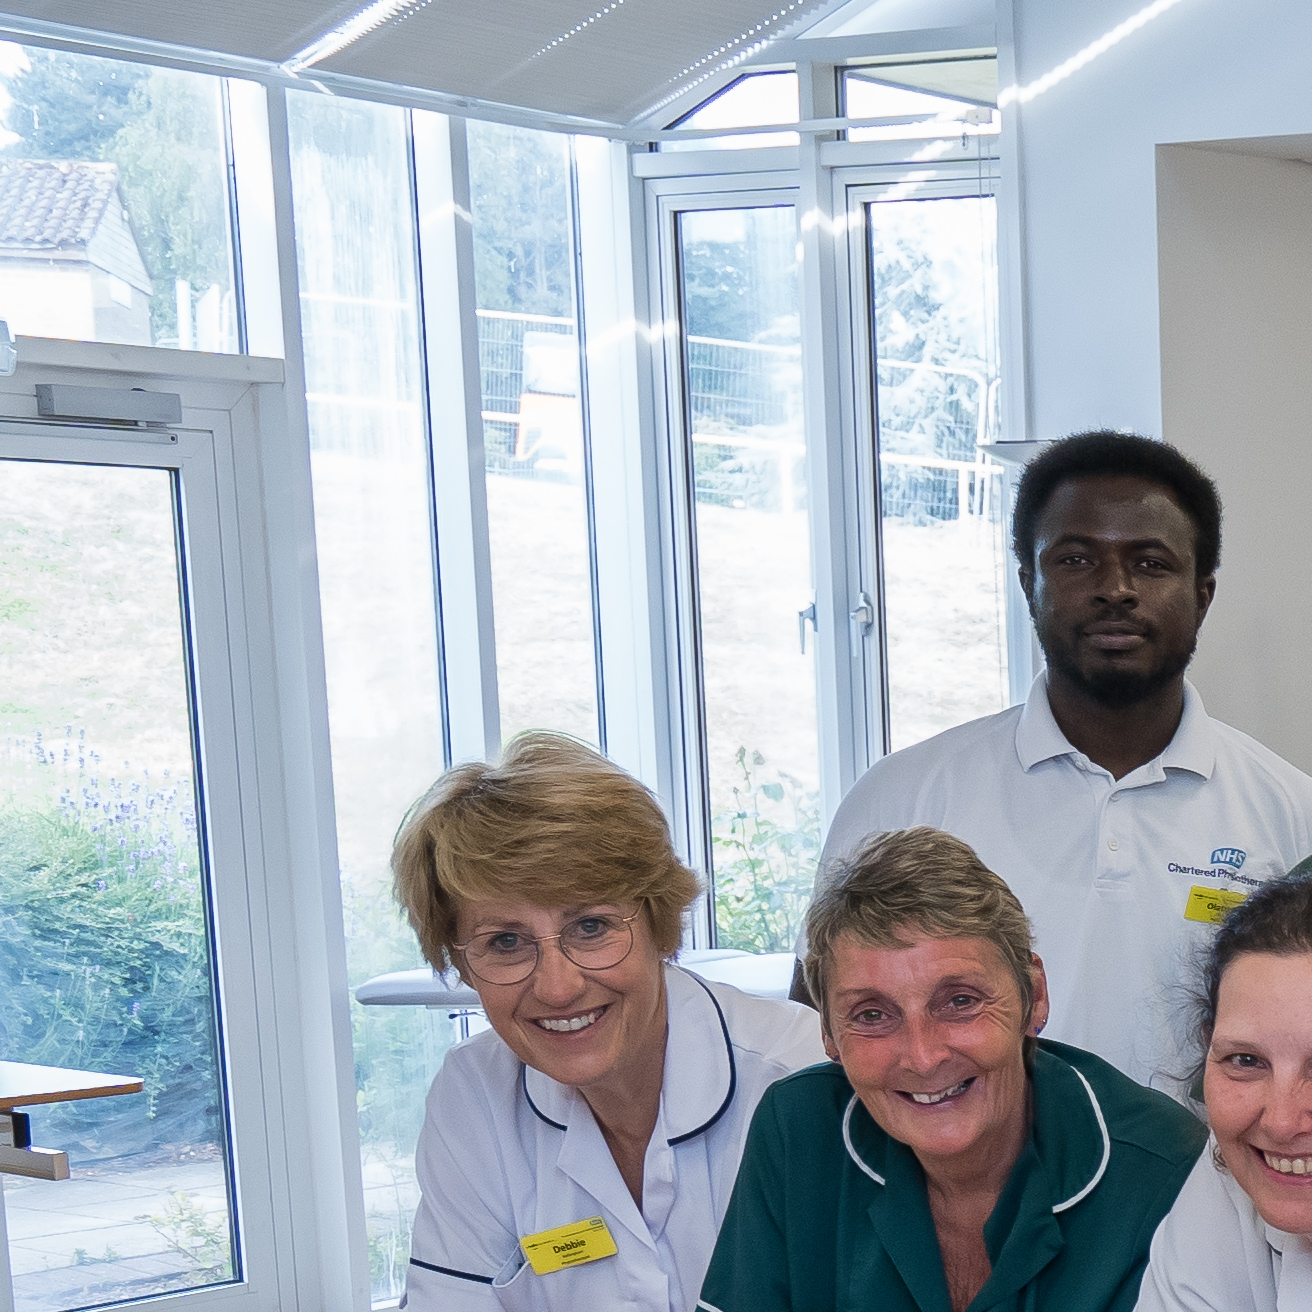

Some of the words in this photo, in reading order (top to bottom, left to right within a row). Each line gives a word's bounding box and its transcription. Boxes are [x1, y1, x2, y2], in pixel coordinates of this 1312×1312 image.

[1213, 850, 1246, 866] NHS
[1167, 862, 1216, 878] Chartered
[552, 1239, 587, 1254] Debbie
